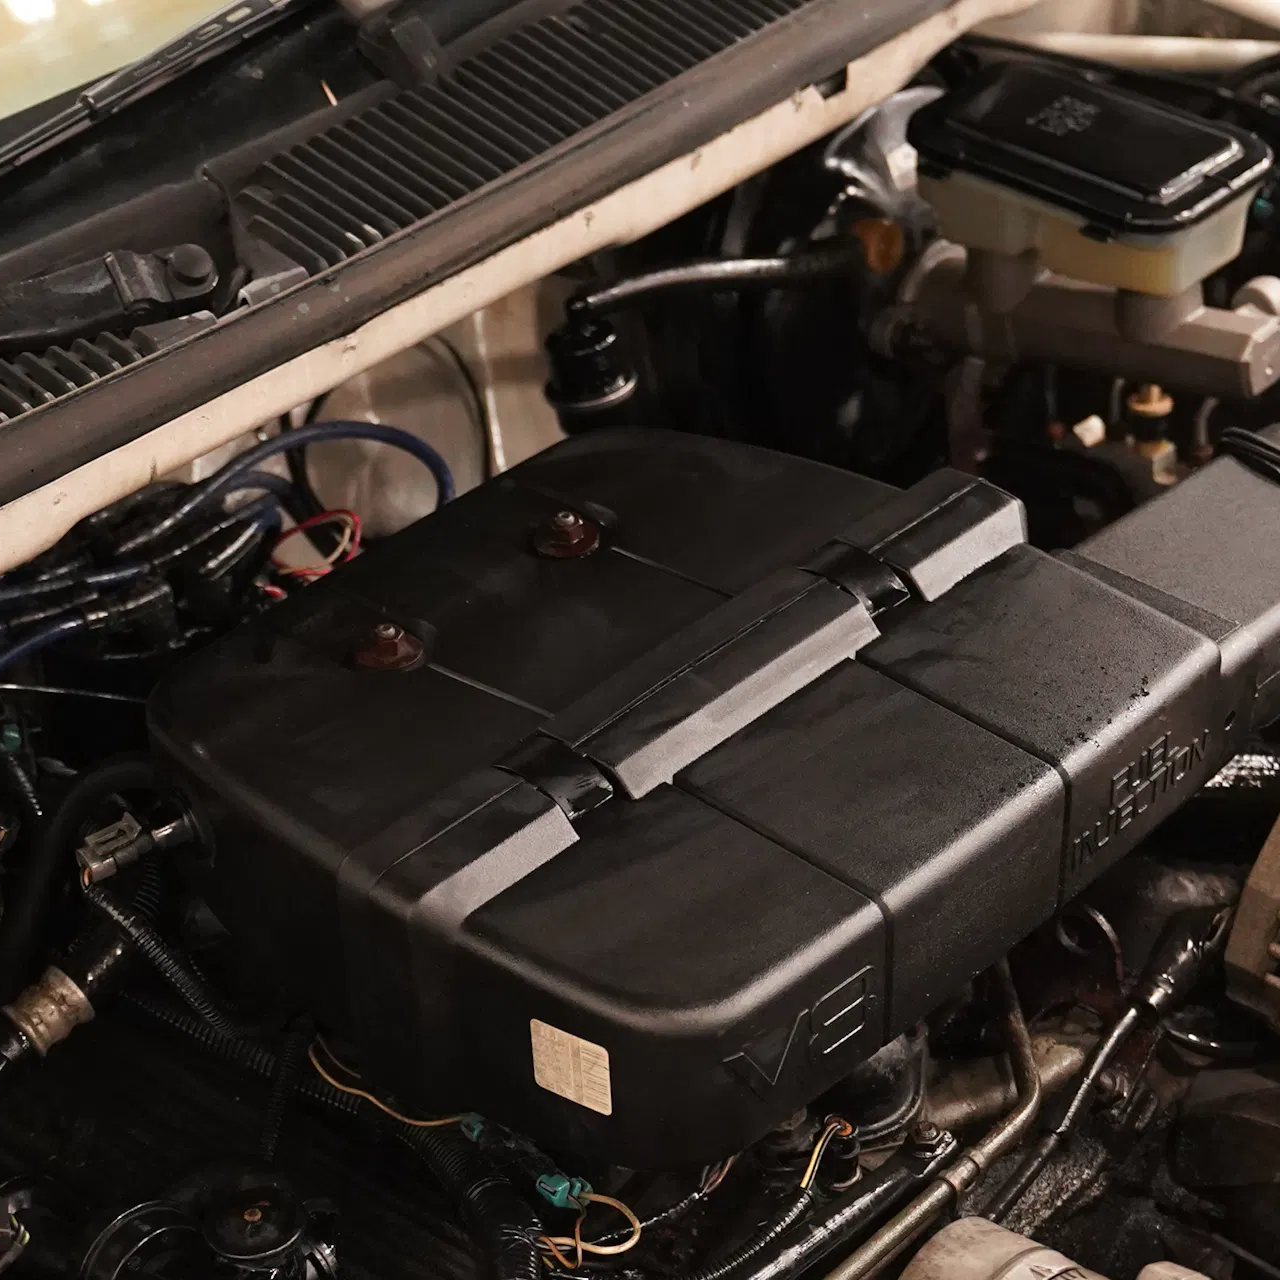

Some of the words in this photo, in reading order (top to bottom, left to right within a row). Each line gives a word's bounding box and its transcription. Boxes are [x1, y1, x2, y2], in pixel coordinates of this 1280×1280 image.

[1071, 729, 1210, 871] INJECTION
[1110, 732, 1179, 809] FUEL
[722, 964, 877, 1102] V8
